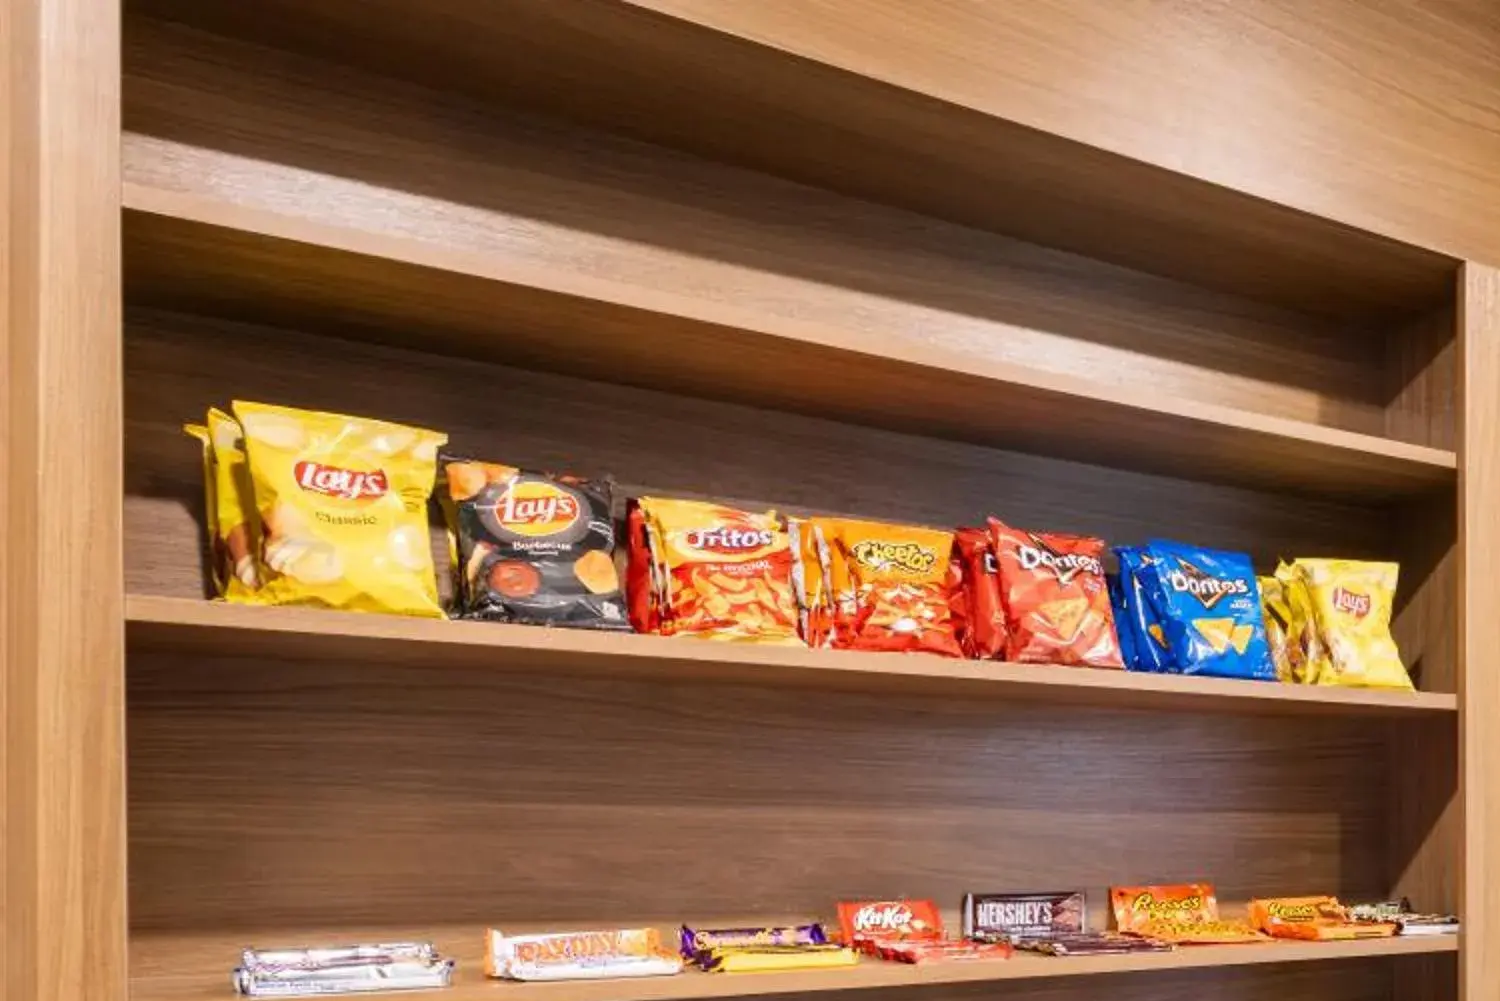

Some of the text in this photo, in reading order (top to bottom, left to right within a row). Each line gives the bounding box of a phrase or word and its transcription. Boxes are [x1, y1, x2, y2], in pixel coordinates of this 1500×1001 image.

[687, 527, 773, 551] Fritos
[854, 541, 936, 574] Cheetos
[1019, 546, 1104, 577] Doritos
[1171, 569, 1249, 595] Doritos
[976, 901, 1053, 929] HERSHEY'S
